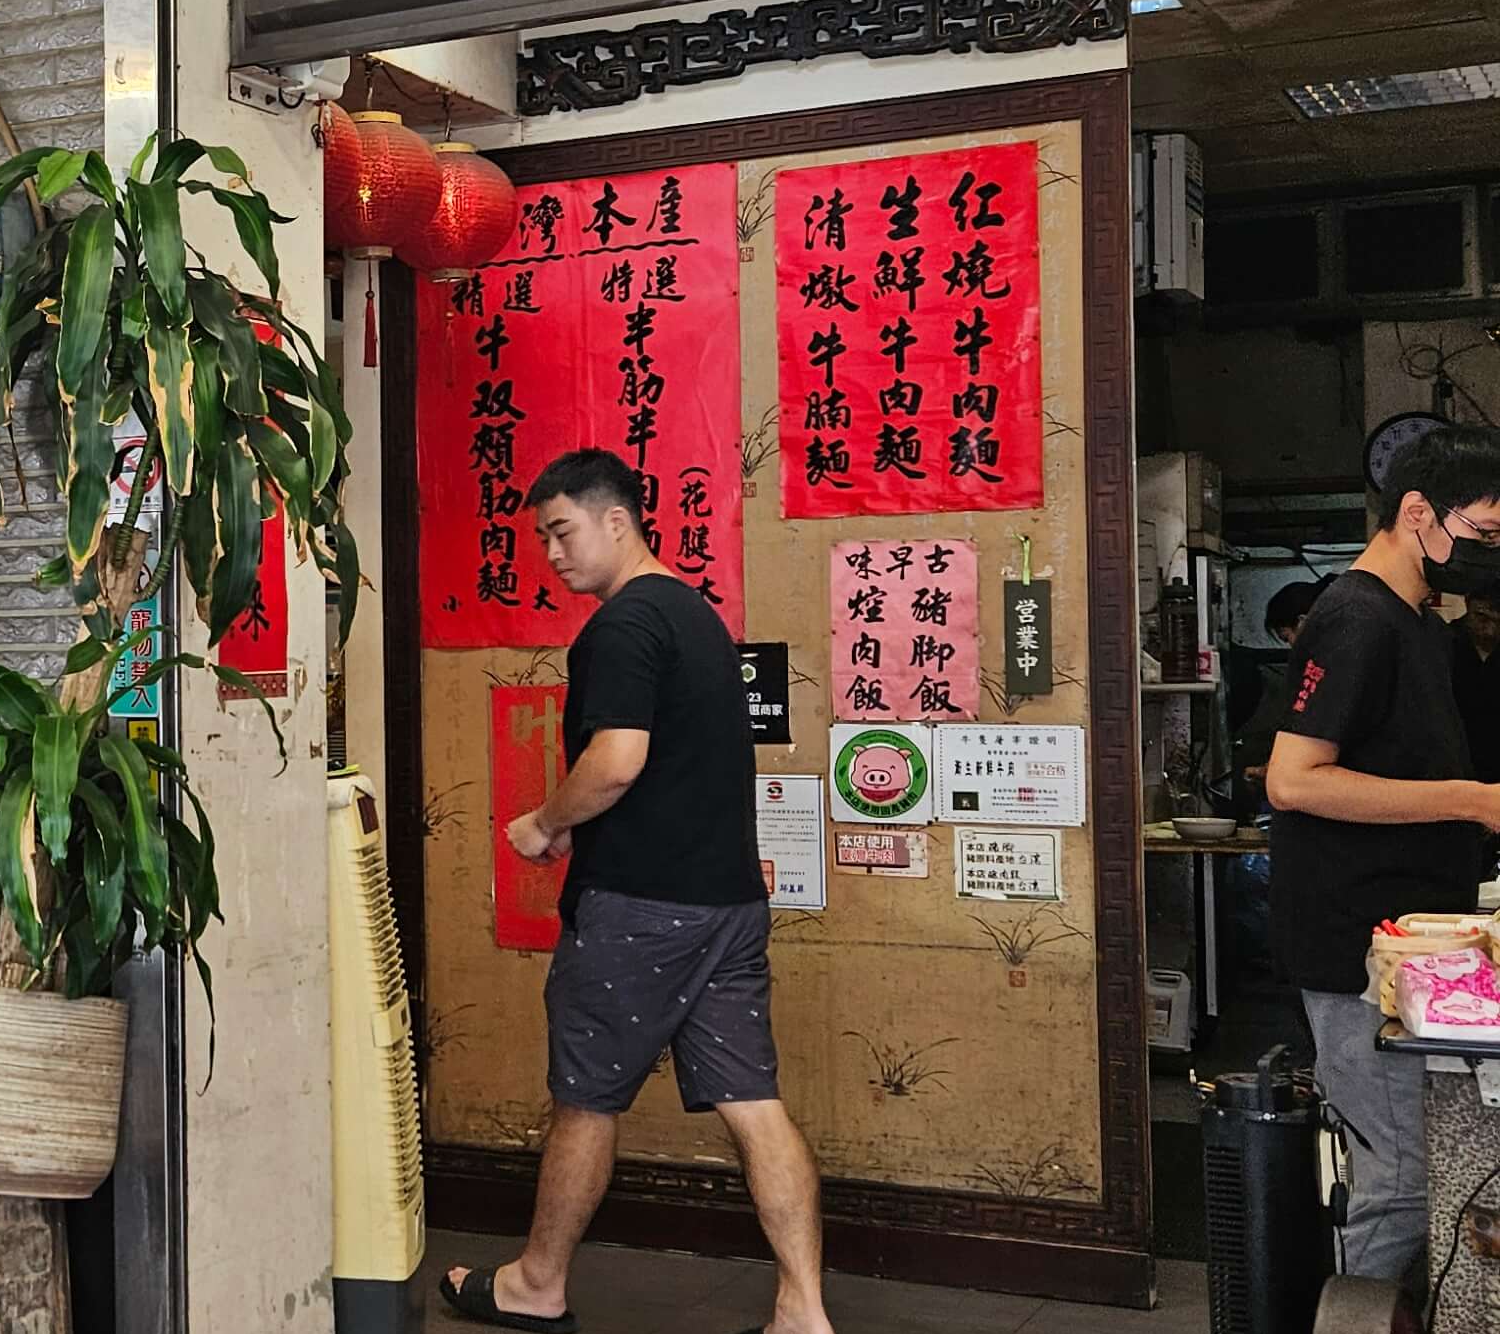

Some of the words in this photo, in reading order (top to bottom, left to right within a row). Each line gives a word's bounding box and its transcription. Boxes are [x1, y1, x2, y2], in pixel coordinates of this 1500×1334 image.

[799, 187, 861, 490] 清燉牛腩麵
[873, 175, 928, 480] 生鮮牛肉麵
[942, 171, 1012, 484] 紅燒牛肉麵
[532, 586, 559, 613] 大
[746, 692, 762, 703] 23
[839, 835, 894, 849] 本店使用
